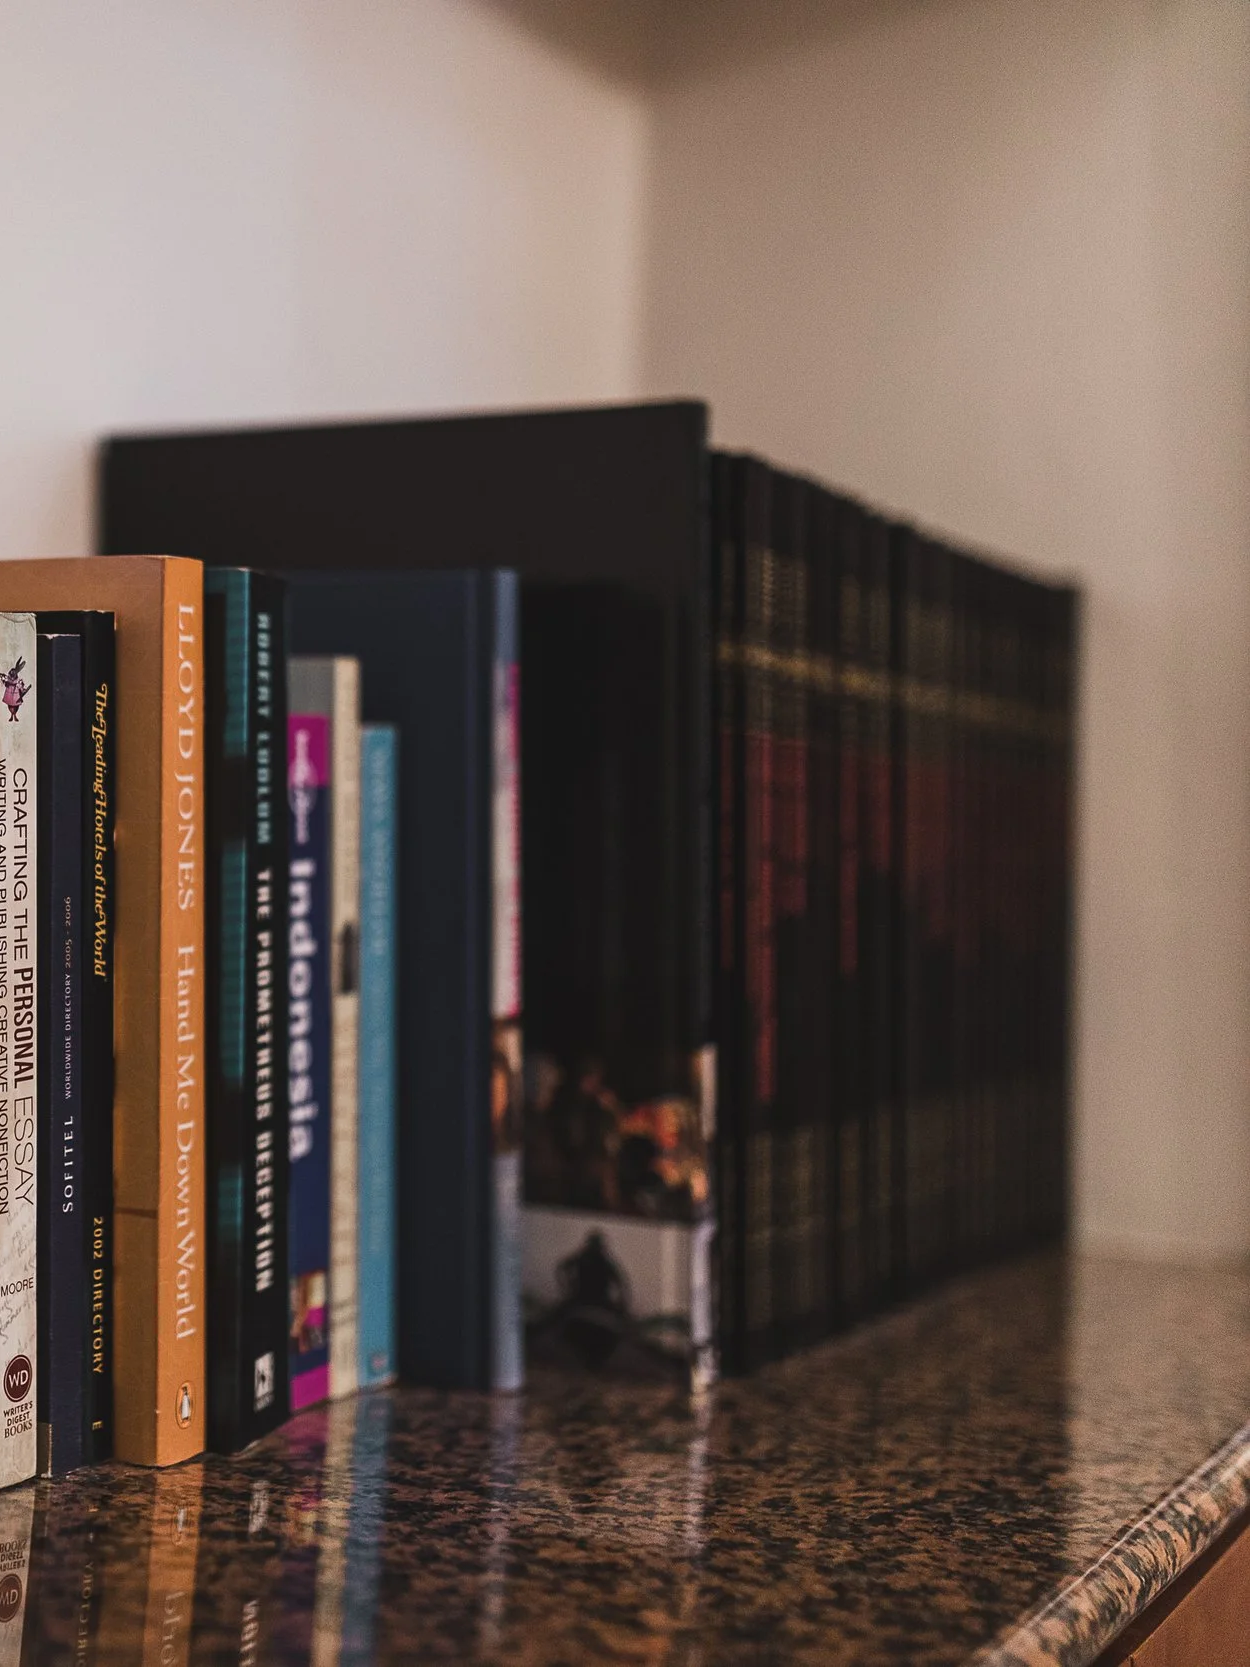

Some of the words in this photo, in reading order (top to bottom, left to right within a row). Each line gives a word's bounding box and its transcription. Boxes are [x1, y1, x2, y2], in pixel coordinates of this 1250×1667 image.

[178, 603, 195, 760] LLOYD
[257, 613, 271, 718] ROBERT
[94, 684, 108, 721] The
[91, 720, 107, 794] Leading
[257, 732, 271, 844] LUDLUM
[13, 767, 28, 902] CRAFTING
[94, 791, 107, 859] Hotels
[175, 773, 195, 911] JONES
[94, 863, 107, 885] of
[94, 885, 106, 914] the
[257, 869, 272, 920] THE
[13, 908, 28, 961] THE
[63, 896, 71, 926] 2006
[94, 911, 107, 977] World
[65, 938, 73, 969] 2005
[64, 973, 72, 1031] DIRECTORY
[177, 945, 195, 1042] Hand
[256, 931, 273, 1121] PROMETHEUS
[289, 859, 317, 1162] Indonesia
[13, 966, 34, 1089] PERSONAL
[64, 1035, 72, 1099] WORLDWIDE
[177, 1054, 195, 1110] Me
[13, 1095, 34, 1206] ESSAY
[62, 1115, 74, 1213] SOFITEL
[177, 1120, 195, 1228] Down
[93, 1217, 103, 1260] 2002
[255, 1131, 273, 1293] DECEPTION
[0, 1276, 34, 1298] MOORE
[177, 1229, 195, 1341] World
[92, 1268, 103, 1374] DIRECTORY
[3, 1401, 33, 1418] WRITER'S
[8, 1369, 29, 1389] WD
[4, 1420, 33, 1438] BOOKS
[7, 1411, 30, 1427] DIGEST
